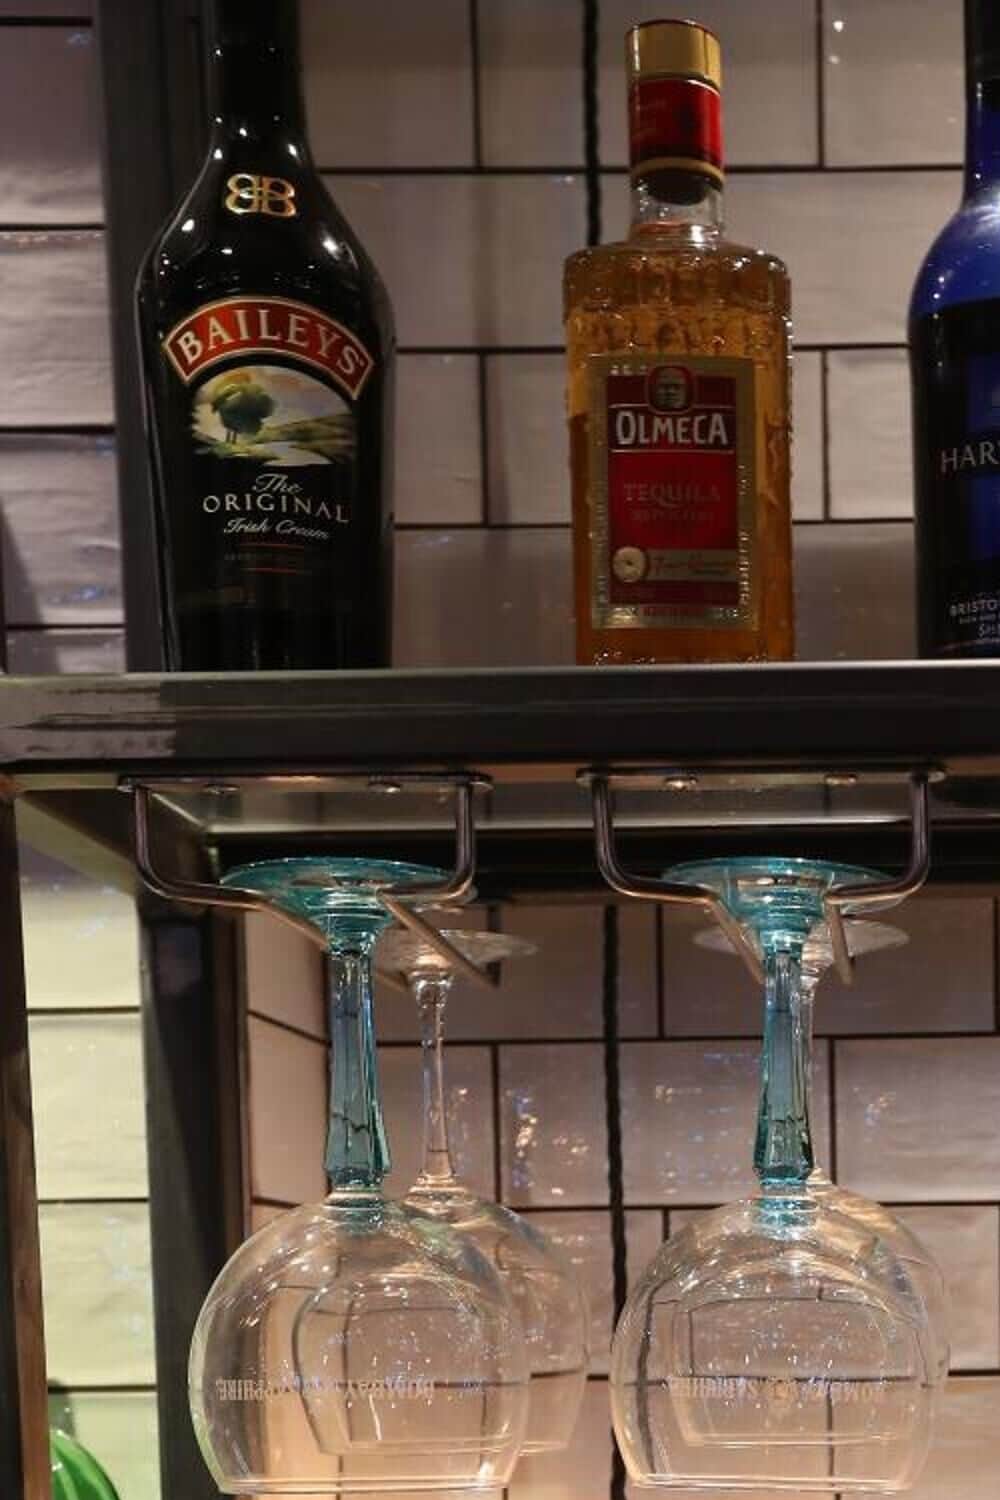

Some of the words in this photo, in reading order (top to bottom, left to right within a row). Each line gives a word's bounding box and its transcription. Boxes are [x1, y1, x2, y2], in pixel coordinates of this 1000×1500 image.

[177, 309, 360, 377] BAILEYS
[615, 411, 728, 445] OLMECA
[252, 473, 303, 493] The
[203, 494, 349, 523] ORIGINAL
[223, 517, 270, 534] Irish
